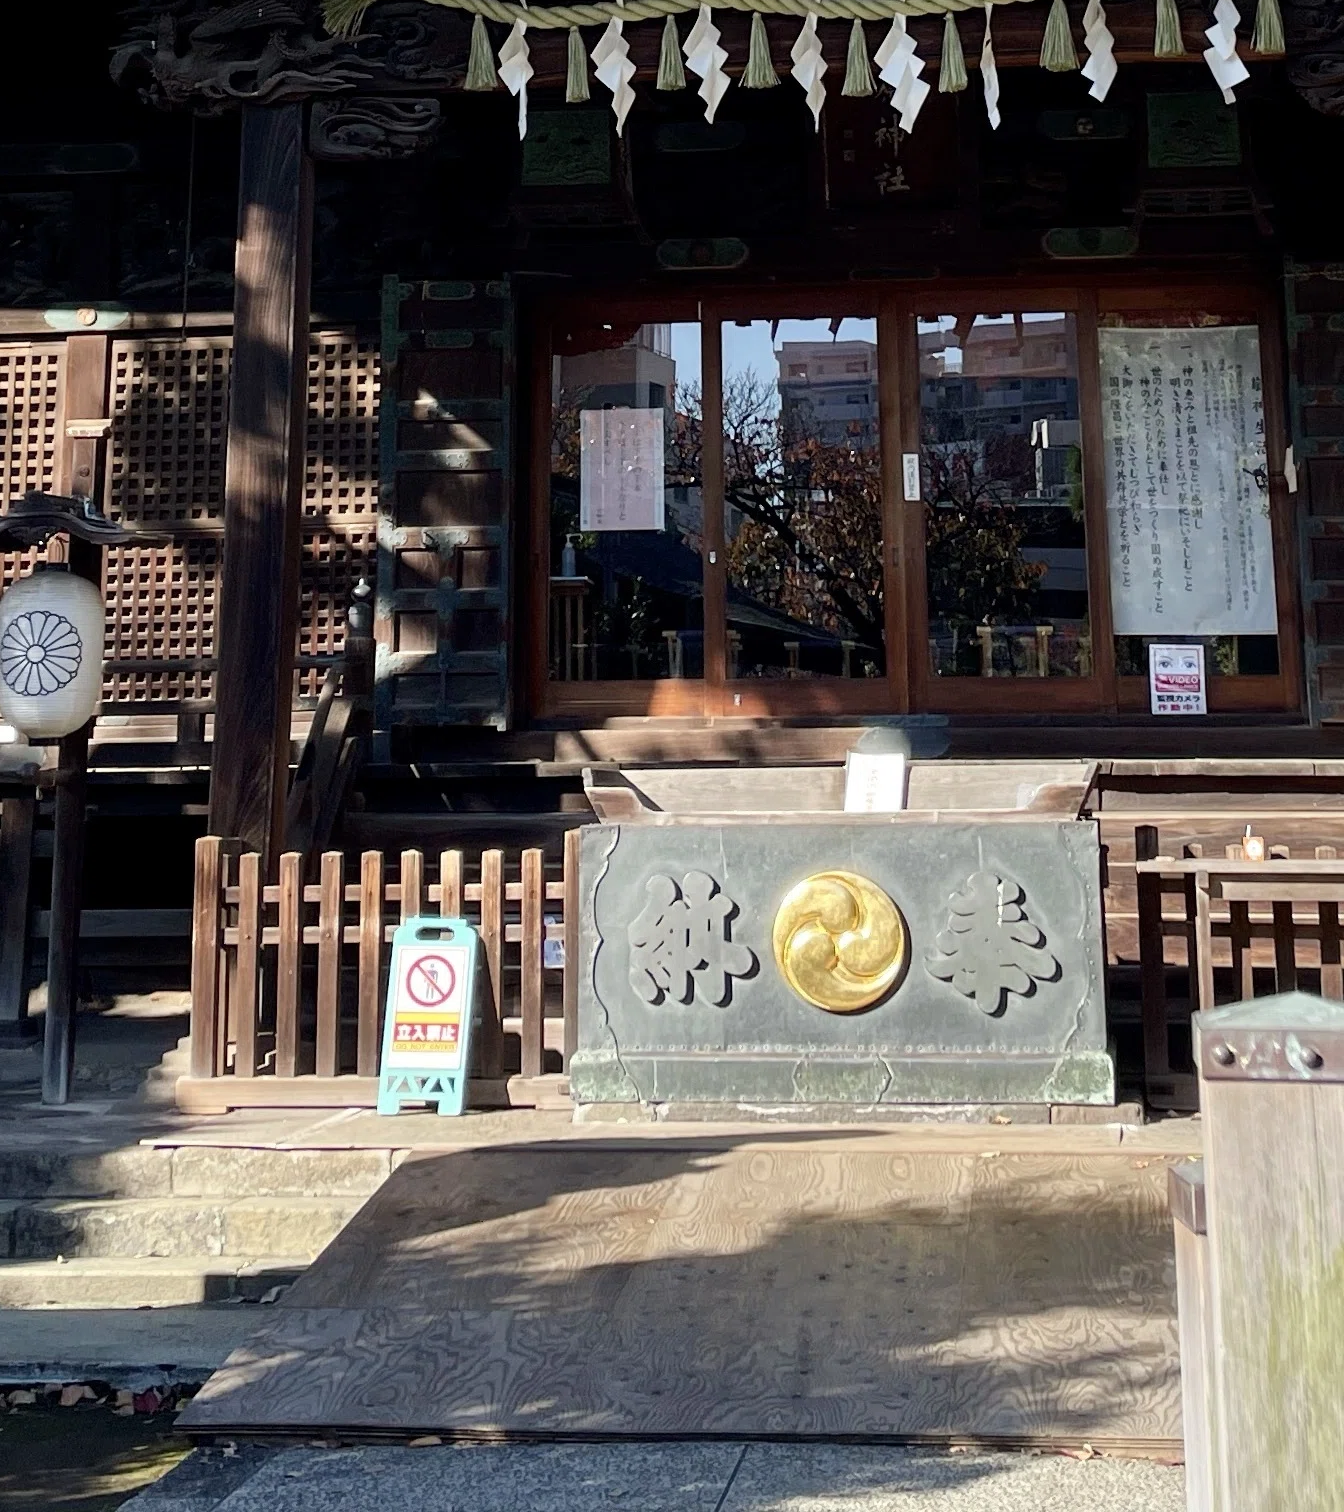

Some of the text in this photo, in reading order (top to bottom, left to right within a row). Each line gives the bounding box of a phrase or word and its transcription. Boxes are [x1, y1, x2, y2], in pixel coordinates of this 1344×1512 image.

[1168, 675, 1199, 684] VIDEO
[1156, 694, 1201, 703] 監視カメラ
[397, 1024, 455, 1041] 立入禁止
